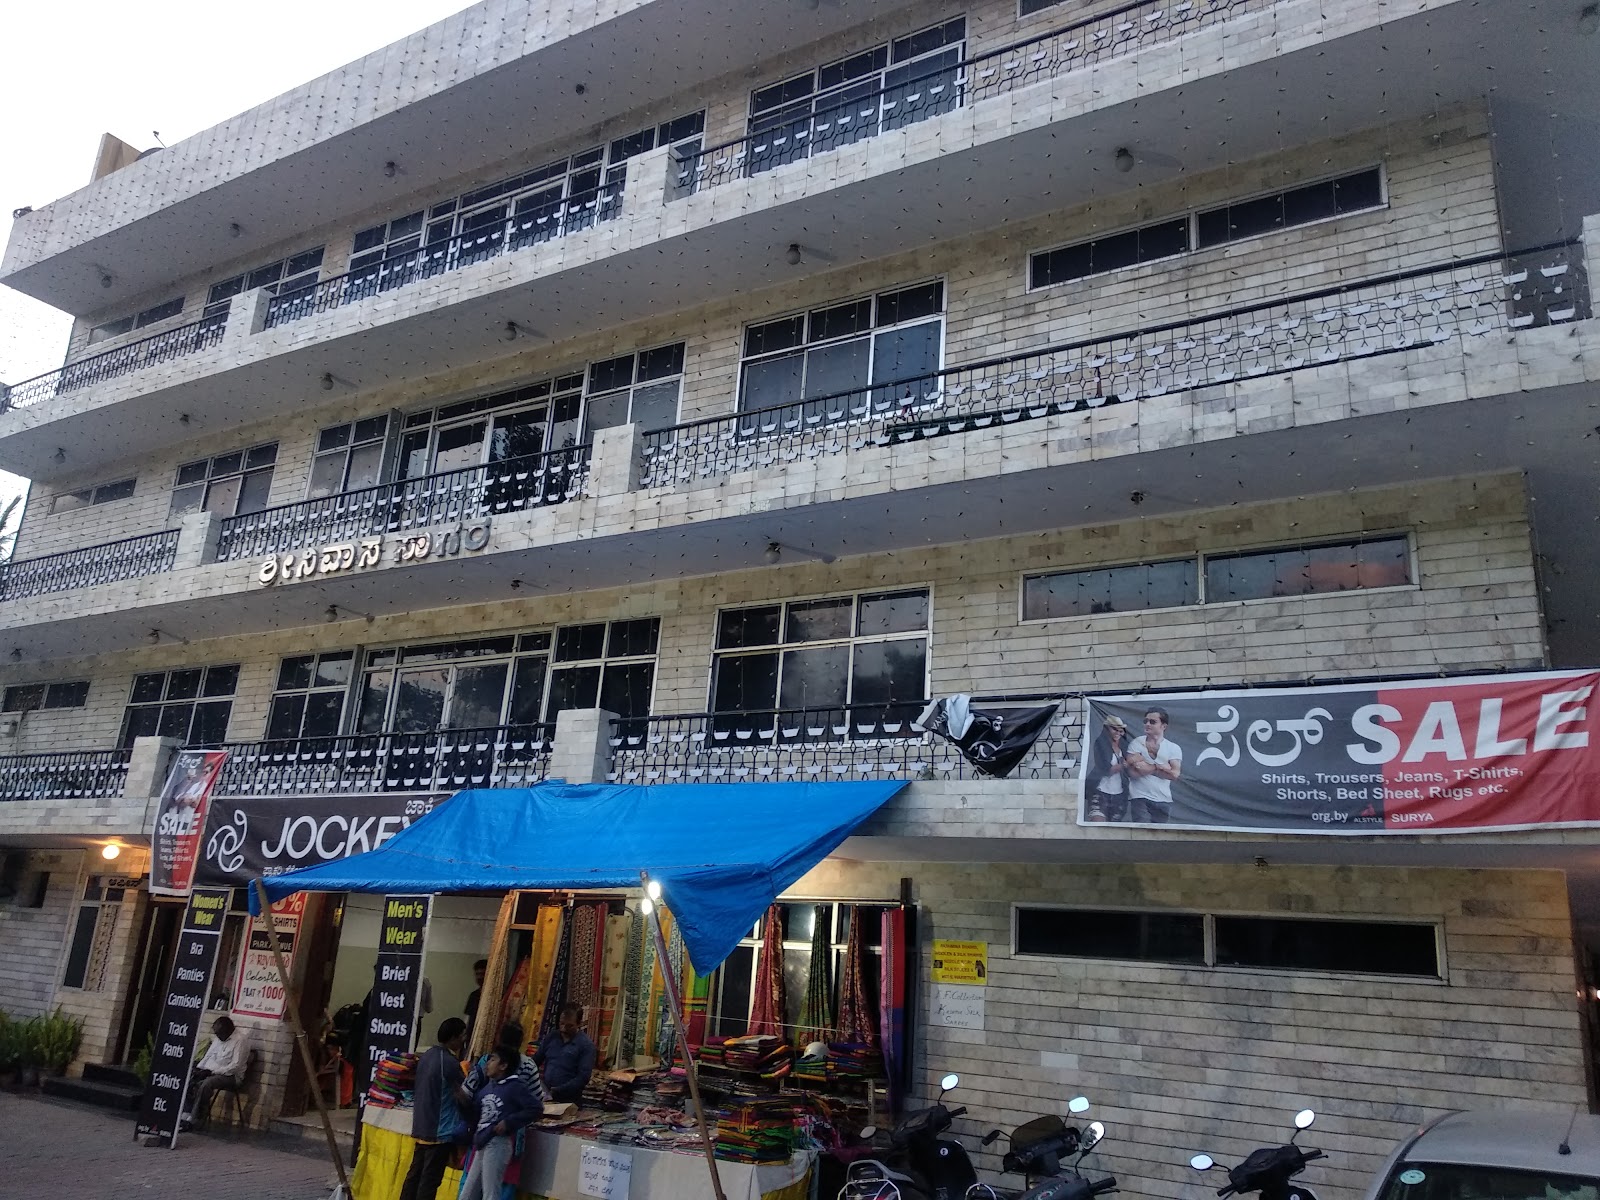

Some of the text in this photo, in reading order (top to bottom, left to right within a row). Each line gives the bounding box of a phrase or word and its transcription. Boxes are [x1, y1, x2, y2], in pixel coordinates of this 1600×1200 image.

[1346, 686, 1593, 765] SALE
[1261, 767, 1524, 785] Shirts, Trousers, Jeans, T-Shirts,
[1276, 784, 1508, 802] Shorts, Bed Sheet, Rugs etc.
[159, 812, 201, 835] SALE
[1311, 811, 1348, 823] org.by
[1391, 812, 1434, 823] SURYA
[192, 893, 225, 910] Women's
[387, 900, 424, 918] Men's
[194, 910, 215, 926] Wear
[385, 926, 417, 945] Wear
[189, 942, 204, 956] Bra
[176, 966, 206, 983] Panties
[381, 965, 411, 981] Brief
[167, 992, 202, 1009] Camisole
[243, 987, 255, 998] FLAT
[380, 991, 405, 1008] Vest
[167, 1021, 189, 1037] Track
[370, 1018, 407, 1036] Shorts
[162, 1042, 185, 1059] Pants
[151, 1072, 182, 1090] T-Shirts
